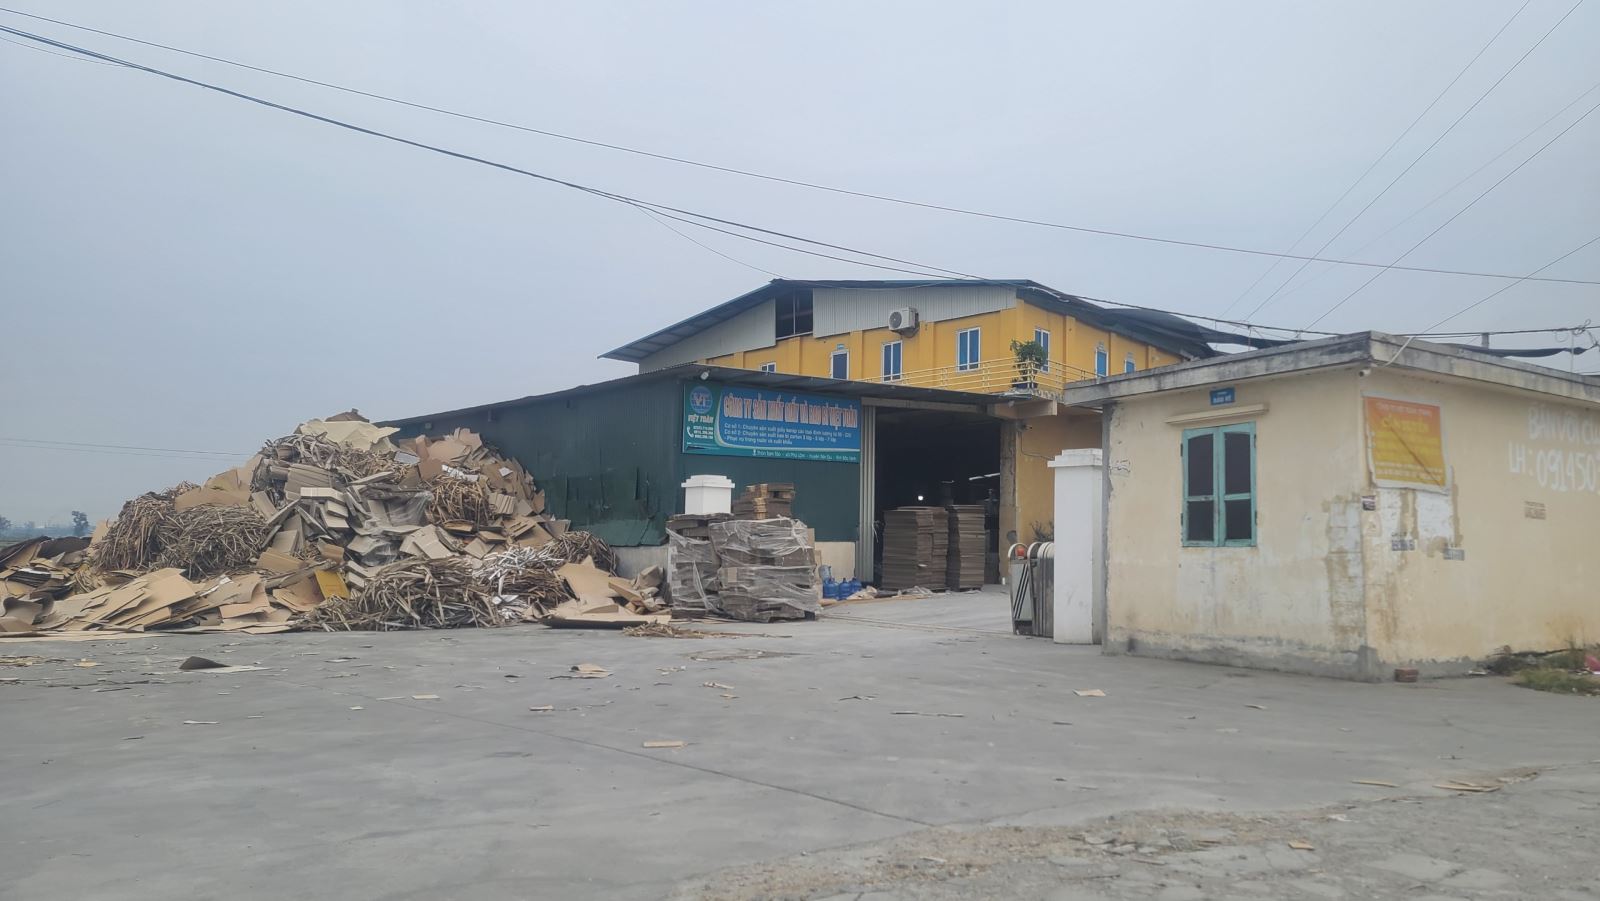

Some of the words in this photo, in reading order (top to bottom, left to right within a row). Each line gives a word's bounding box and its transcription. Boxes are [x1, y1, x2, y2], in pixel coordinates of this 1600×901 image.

[724, 392, 743, 419] CÔNG
[744, 399, 752, 418] TY
[753, 392, 767, 420] SẢN
[829, 403, 842, 430] VIỆT
